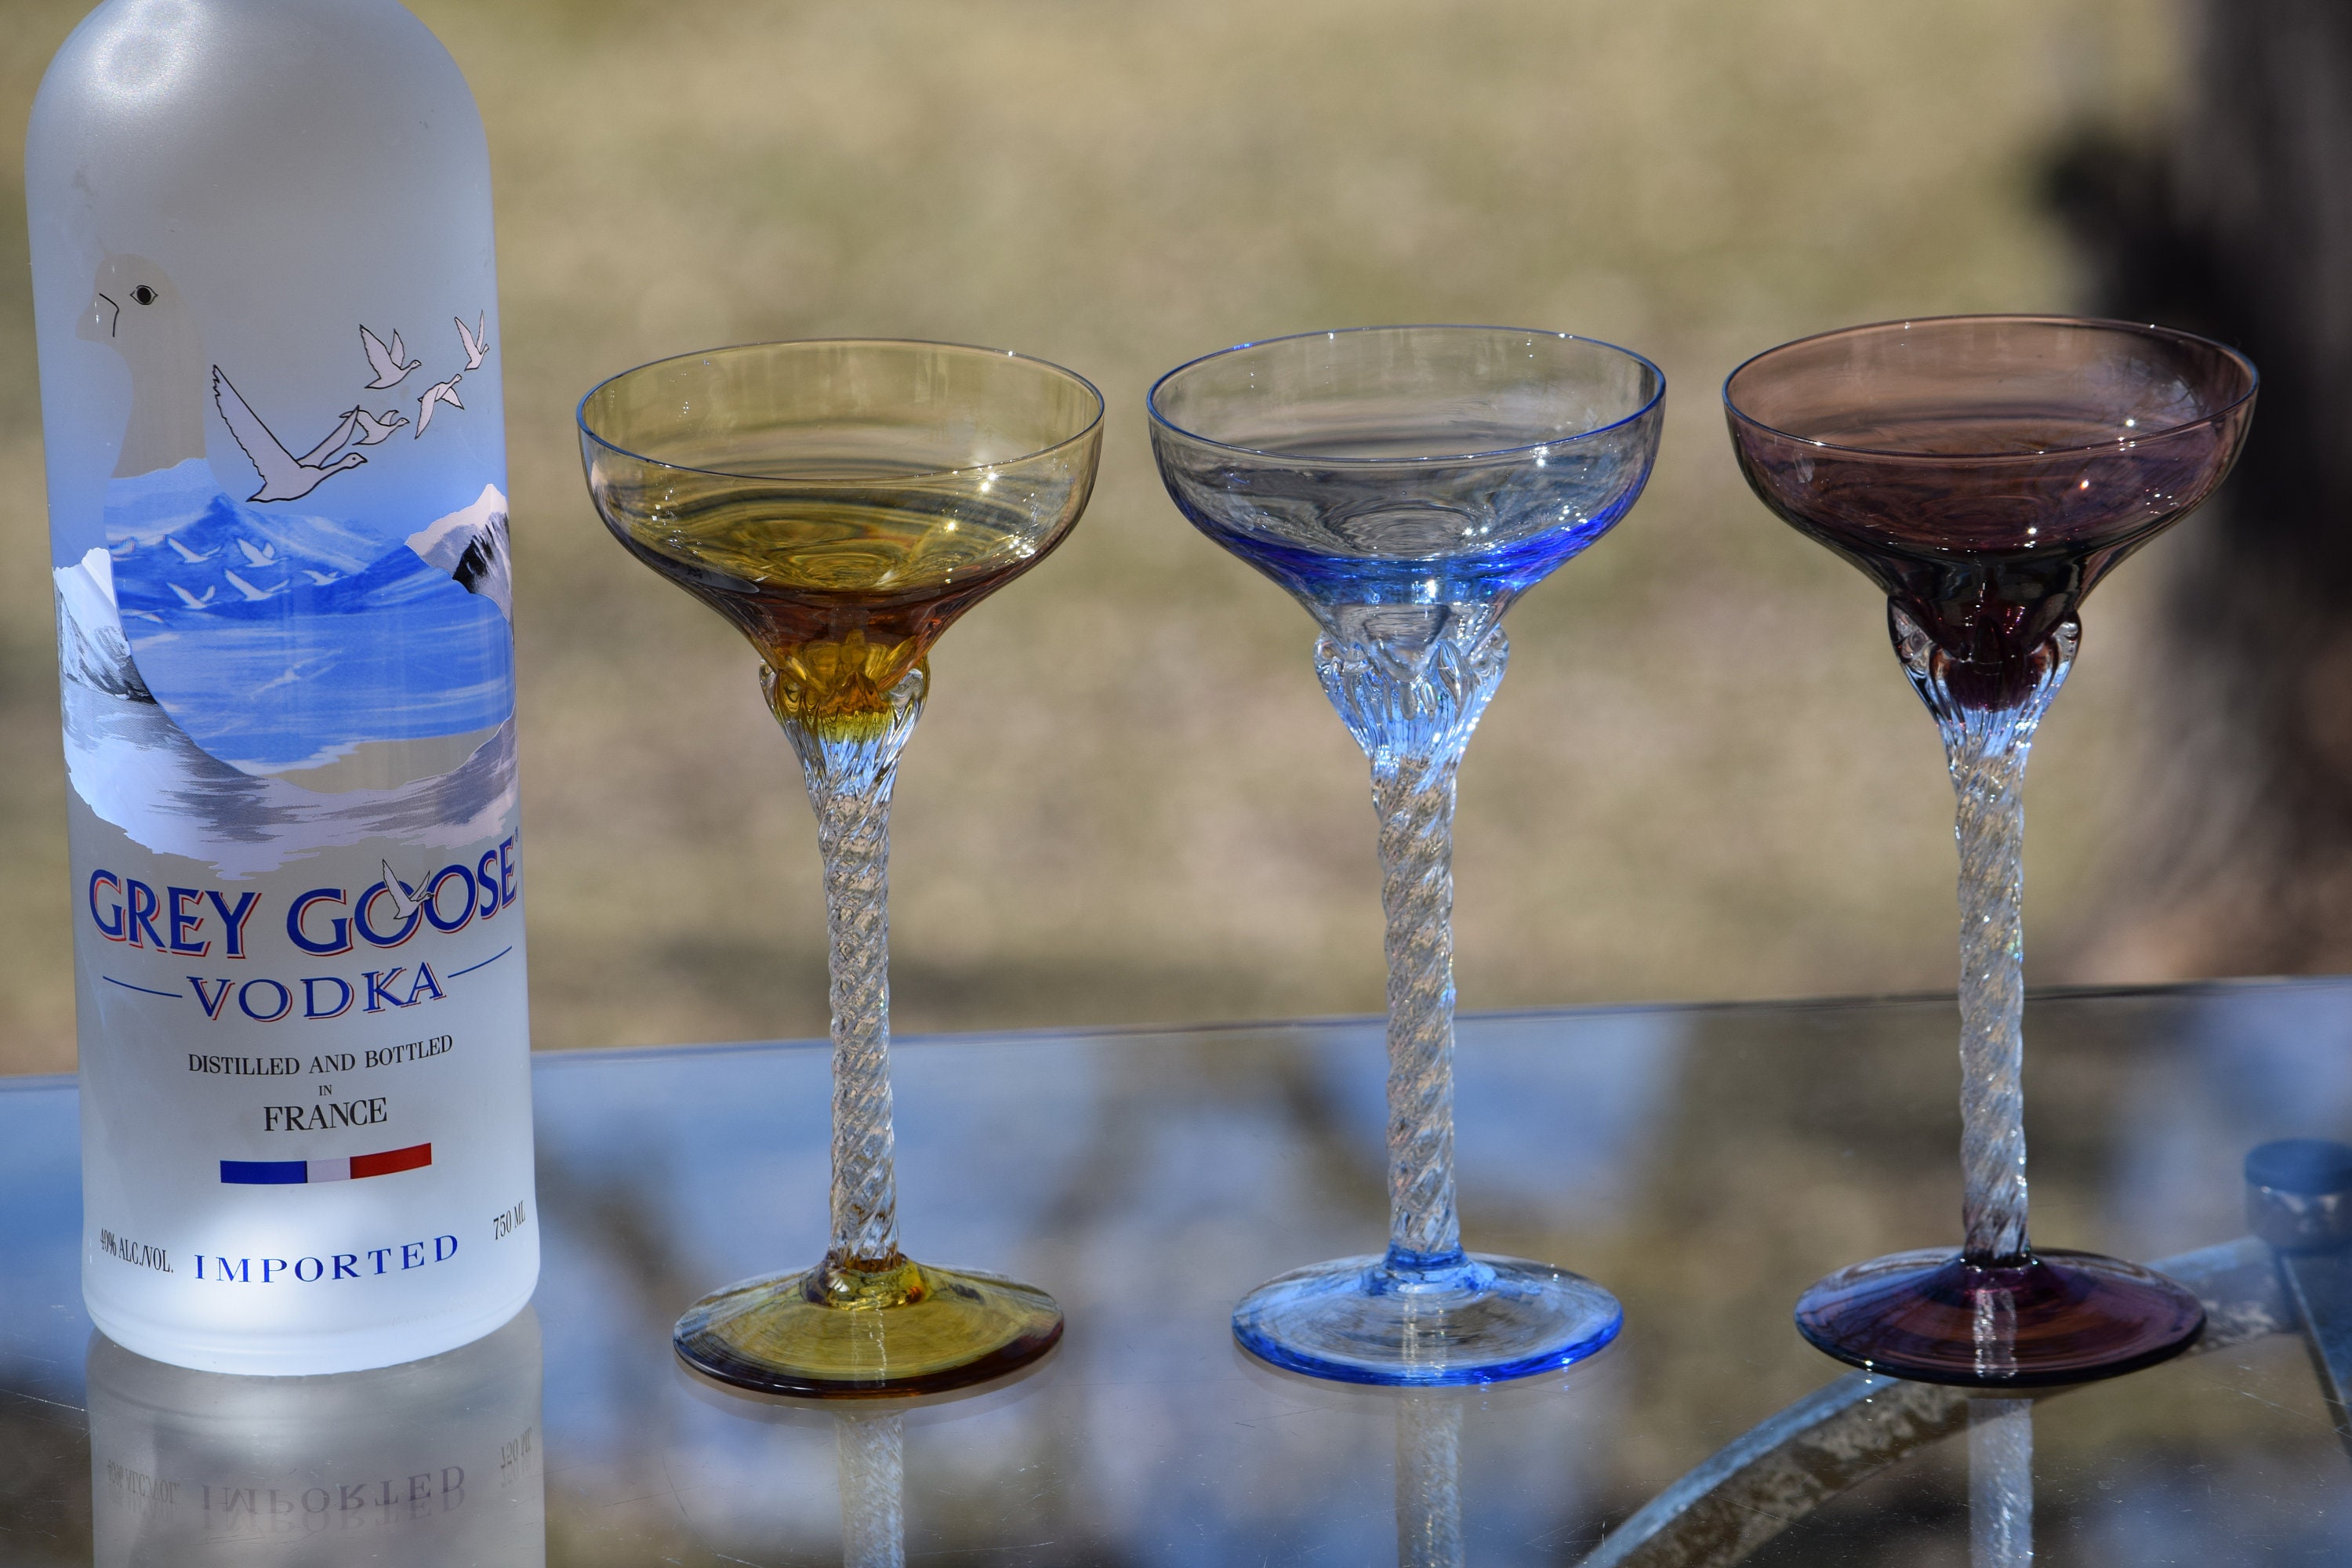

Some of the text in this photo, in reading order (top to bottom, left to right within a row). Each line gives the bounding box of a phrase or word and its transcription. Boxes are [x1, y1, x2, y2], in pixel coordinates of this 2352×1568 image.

[89, 834, 517, 959] GREY GOOSE
[187, 961, 447, 1022] VODKA
[188, 1034, 453, 1076] DISTILLED AND BOTTLED
[318, 1084, 332, 1096] IN
[263, 1097, 387, 1131] FRANCE
[493, 1200, 526, 1240] 750 ML
[100, 1227, 117, 1257] 40%
[194, 1234, 459, 1284] IMPORTED
